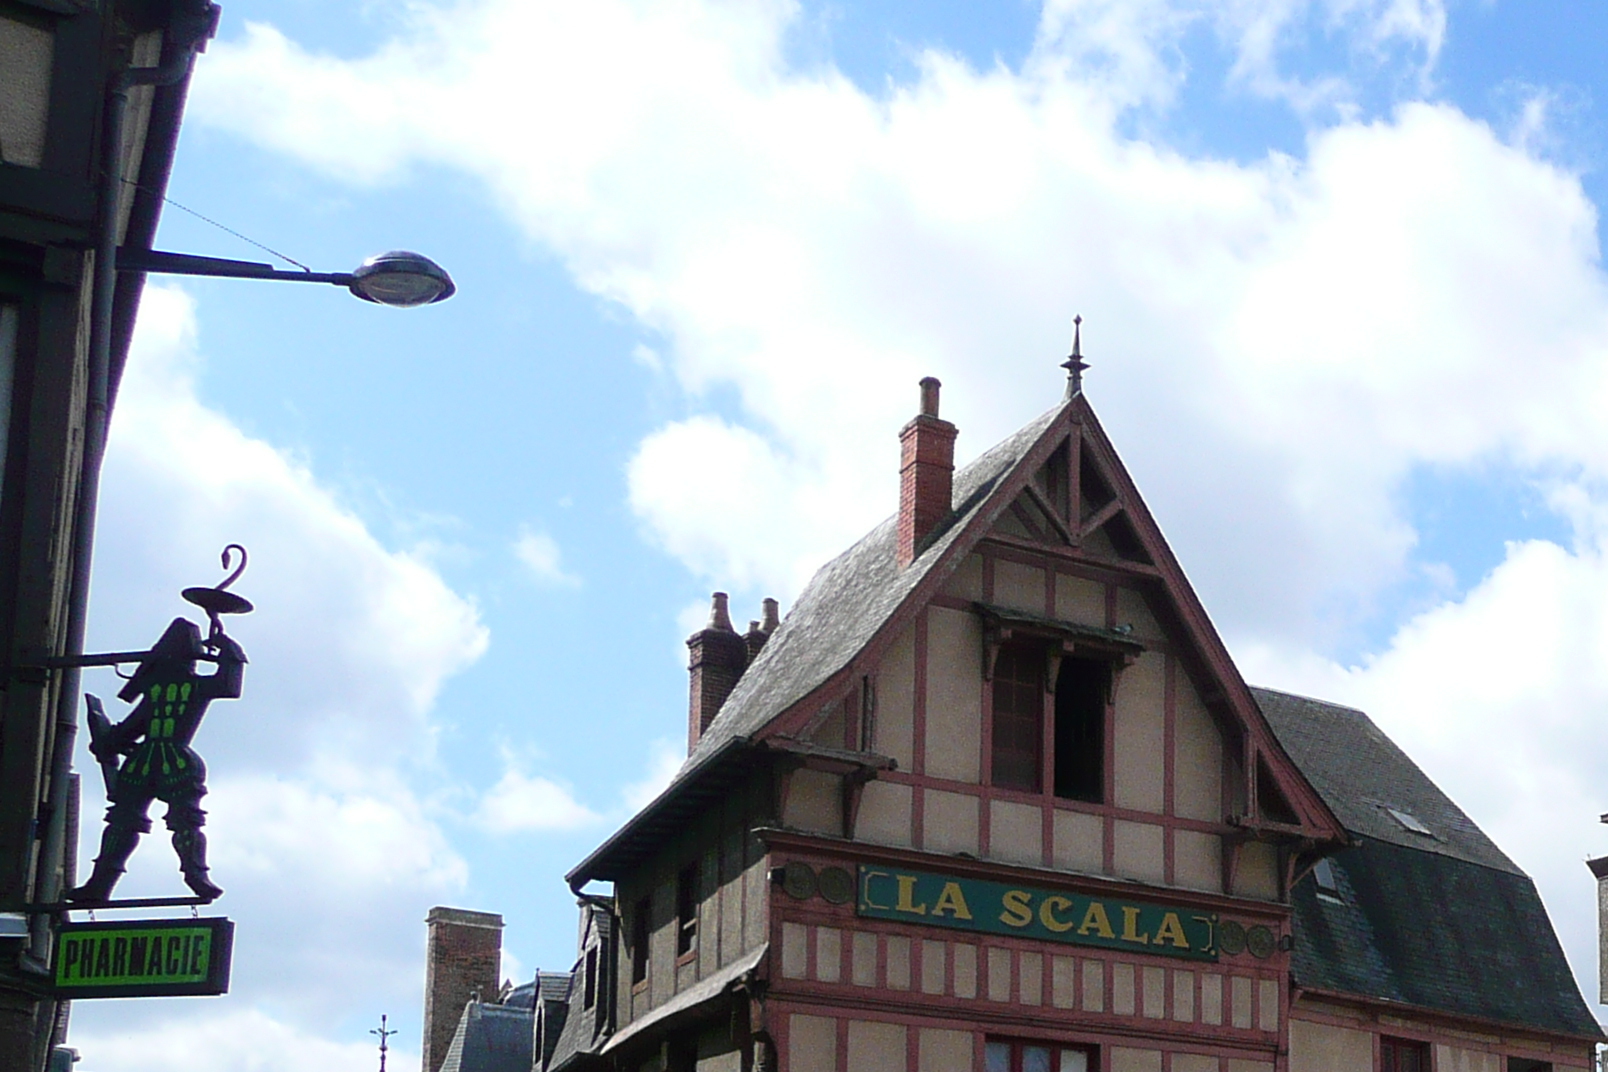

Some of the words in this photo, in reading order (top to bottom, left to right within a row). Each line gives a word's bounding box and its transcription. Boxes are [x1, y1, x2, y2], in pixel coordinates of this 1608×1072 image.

[895, 874, 973, 920] LA
[999, 889, 1190, 949] SCALA
[64, 934, 205, 979] PHARMACIE
